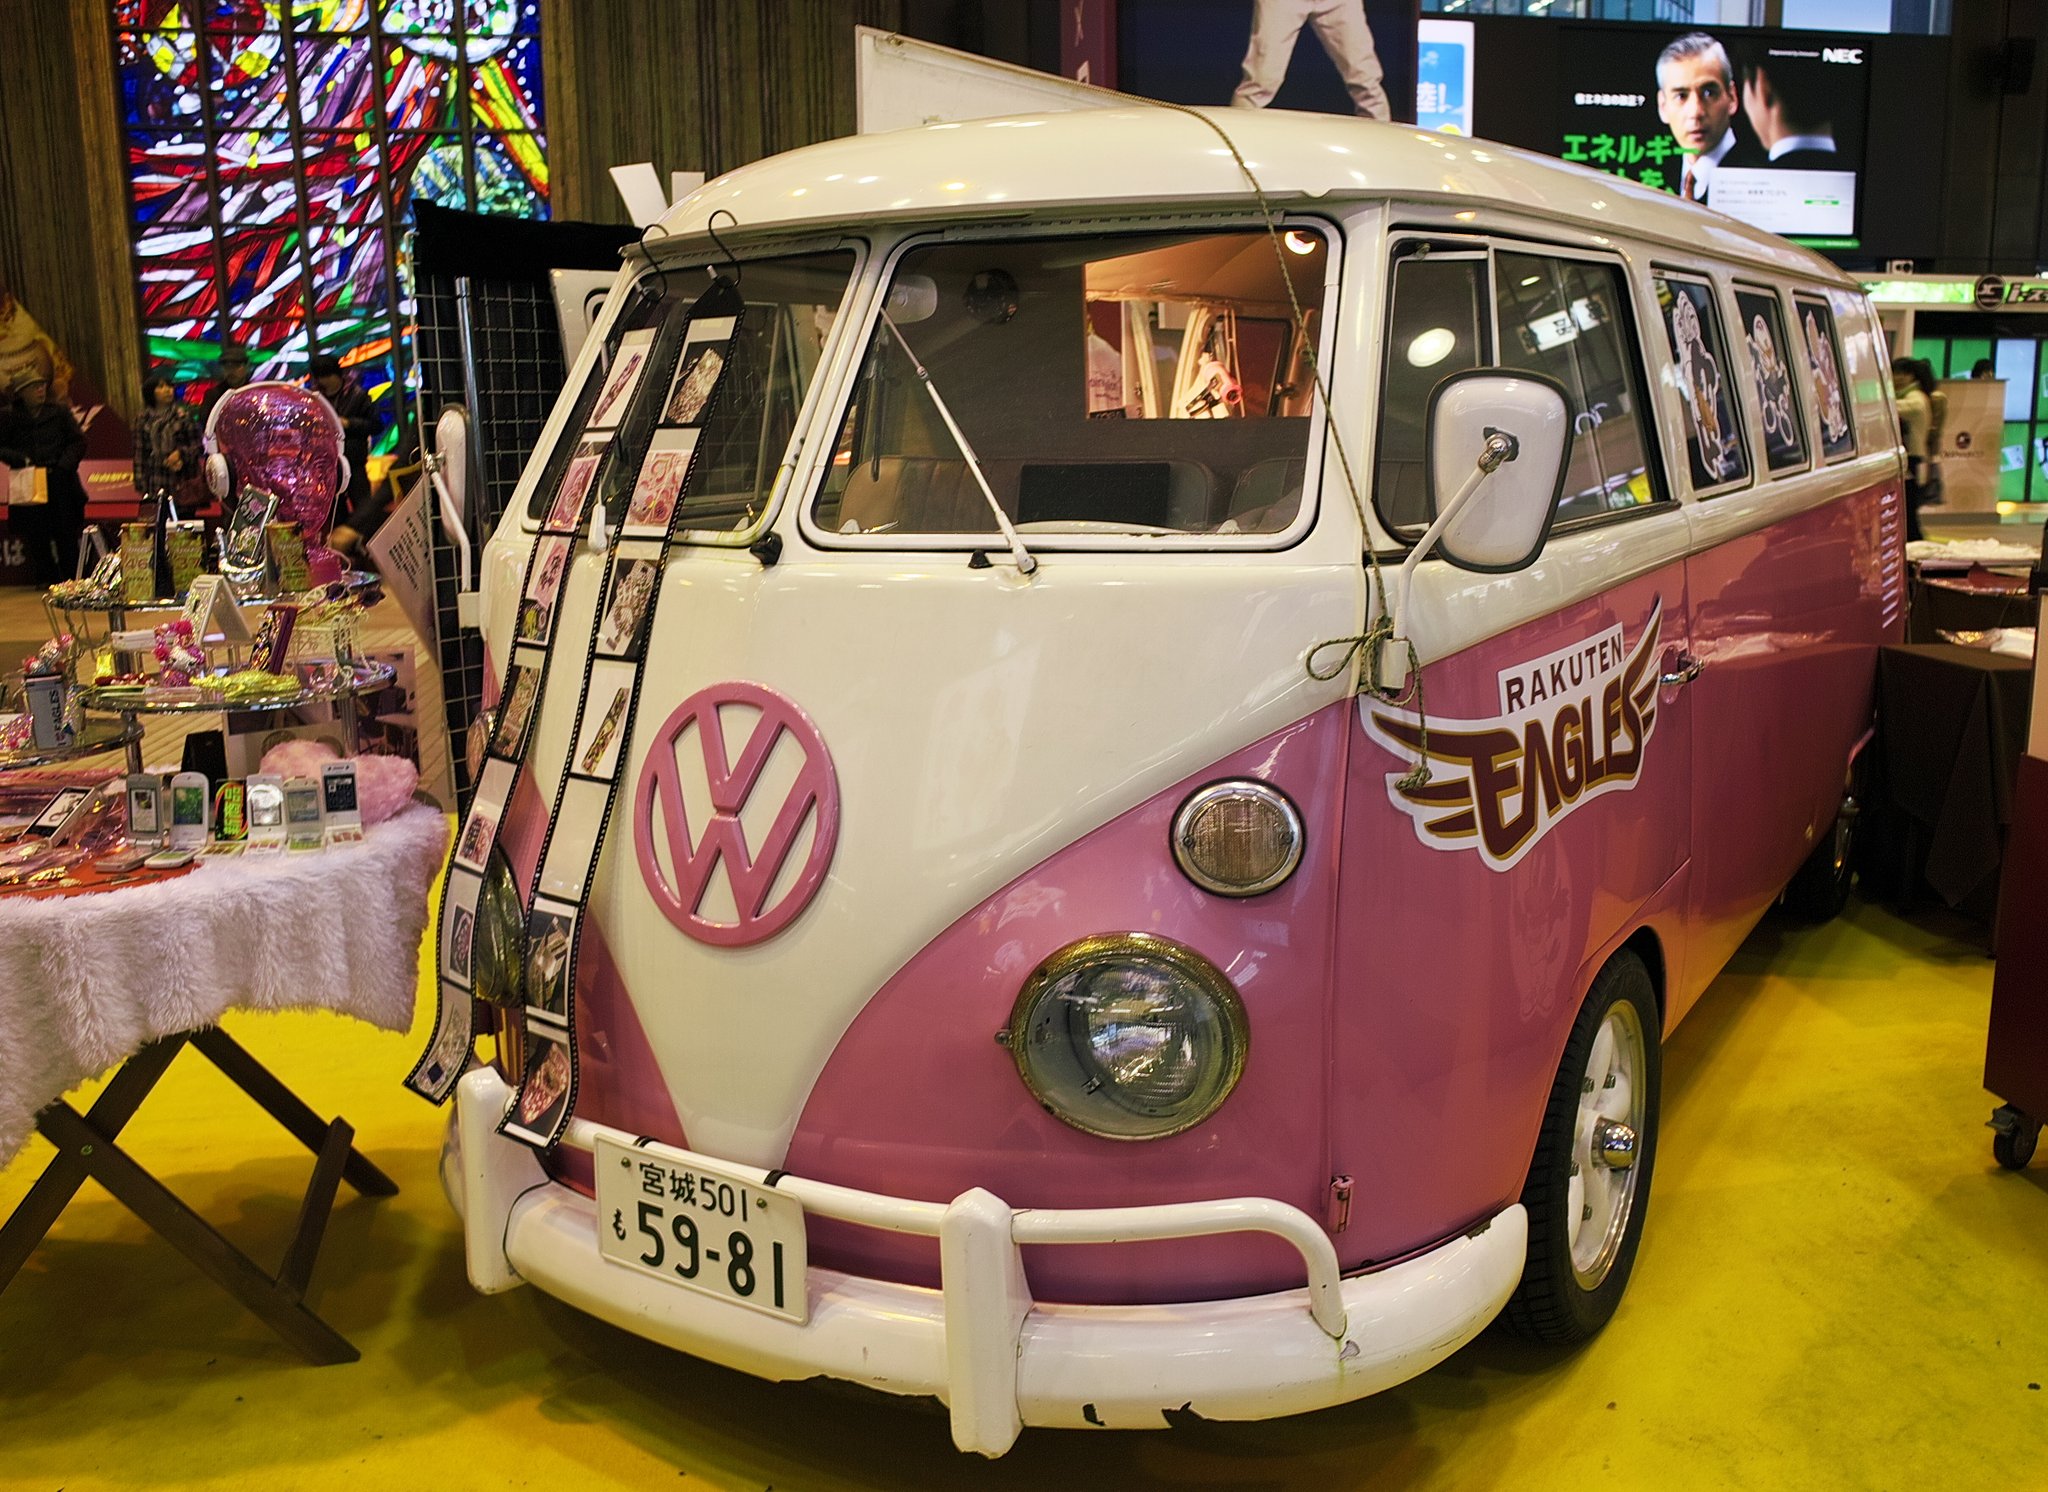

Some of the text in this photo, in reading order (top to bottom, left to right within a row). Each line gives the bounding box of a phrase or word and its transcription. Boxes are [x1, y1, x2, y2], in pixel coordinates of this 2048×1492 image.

[1822, 48, 1863, 64] NEC
[1562, 134, 1700, 165] エネルギー
[1504, 633, 1623, 714] RAKUTEN
[1442, 655, 1650, 860] EAGLES
[612, 1200, 785, 1309] も 59-81
